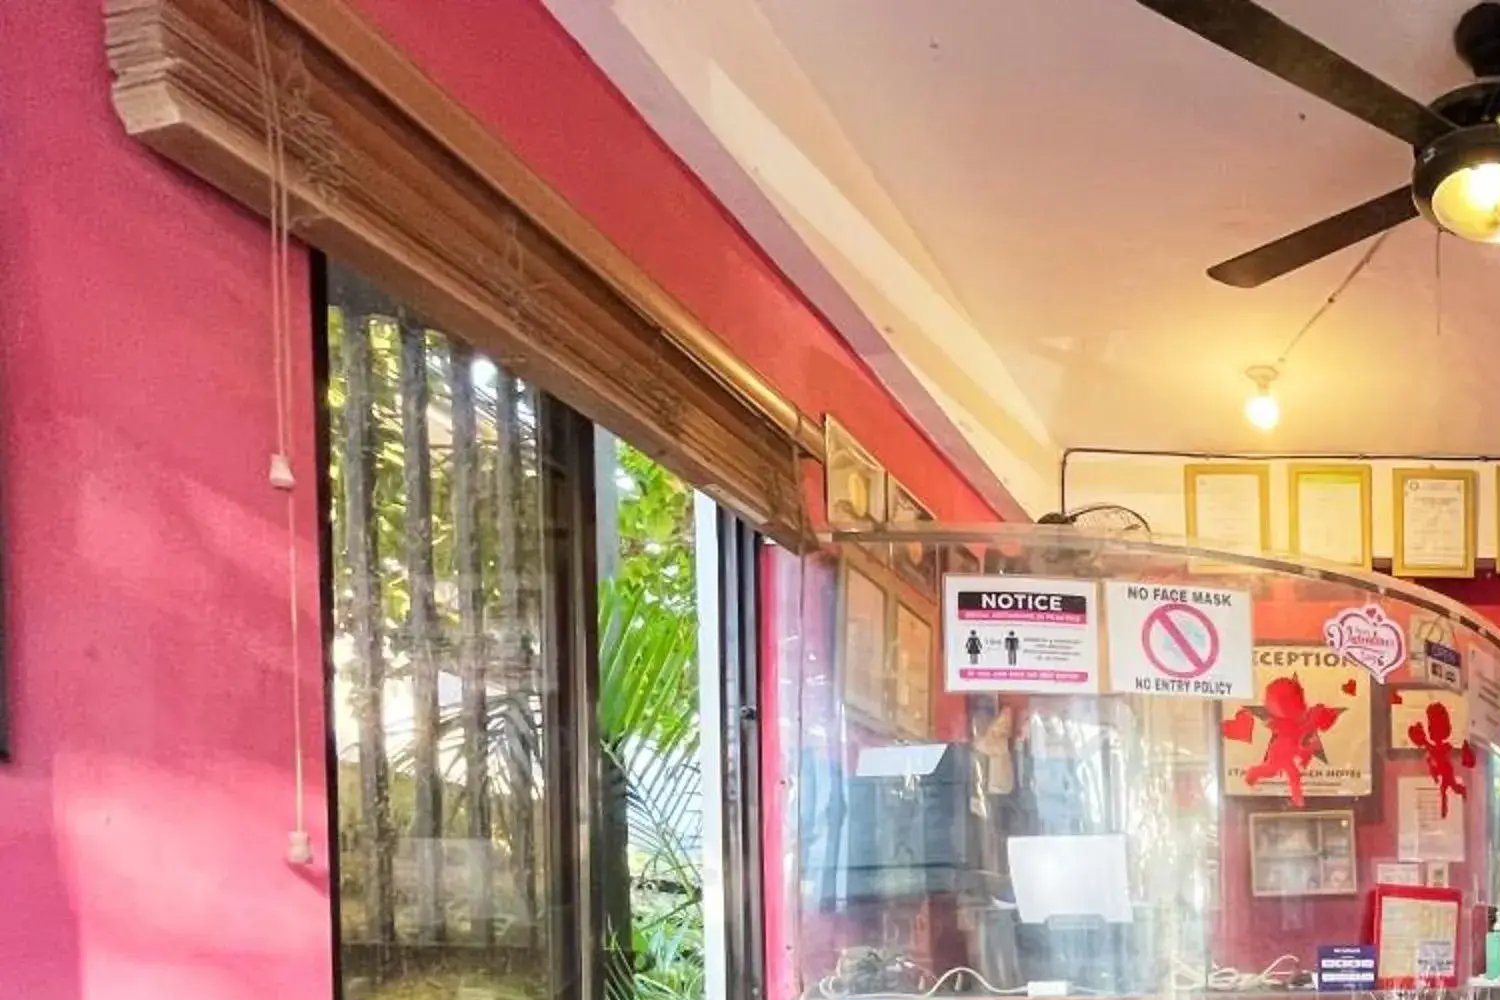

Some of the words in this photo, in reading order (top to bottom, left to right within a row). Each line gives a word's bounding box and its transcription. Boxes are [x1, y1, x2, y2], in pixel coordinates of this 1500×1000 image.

[981, 593, 1062, 611] NOTICE
[1127, 585, 1149, 600] NO
[1153, 588, 1188, 602] FACE
[1192, 591, 1233, 606] MASK
[1135, 677, 1151, 690] NO
[1155, 678, 1190, 692] ENTRY
[1194, 680, 1233, 695] POLICY
